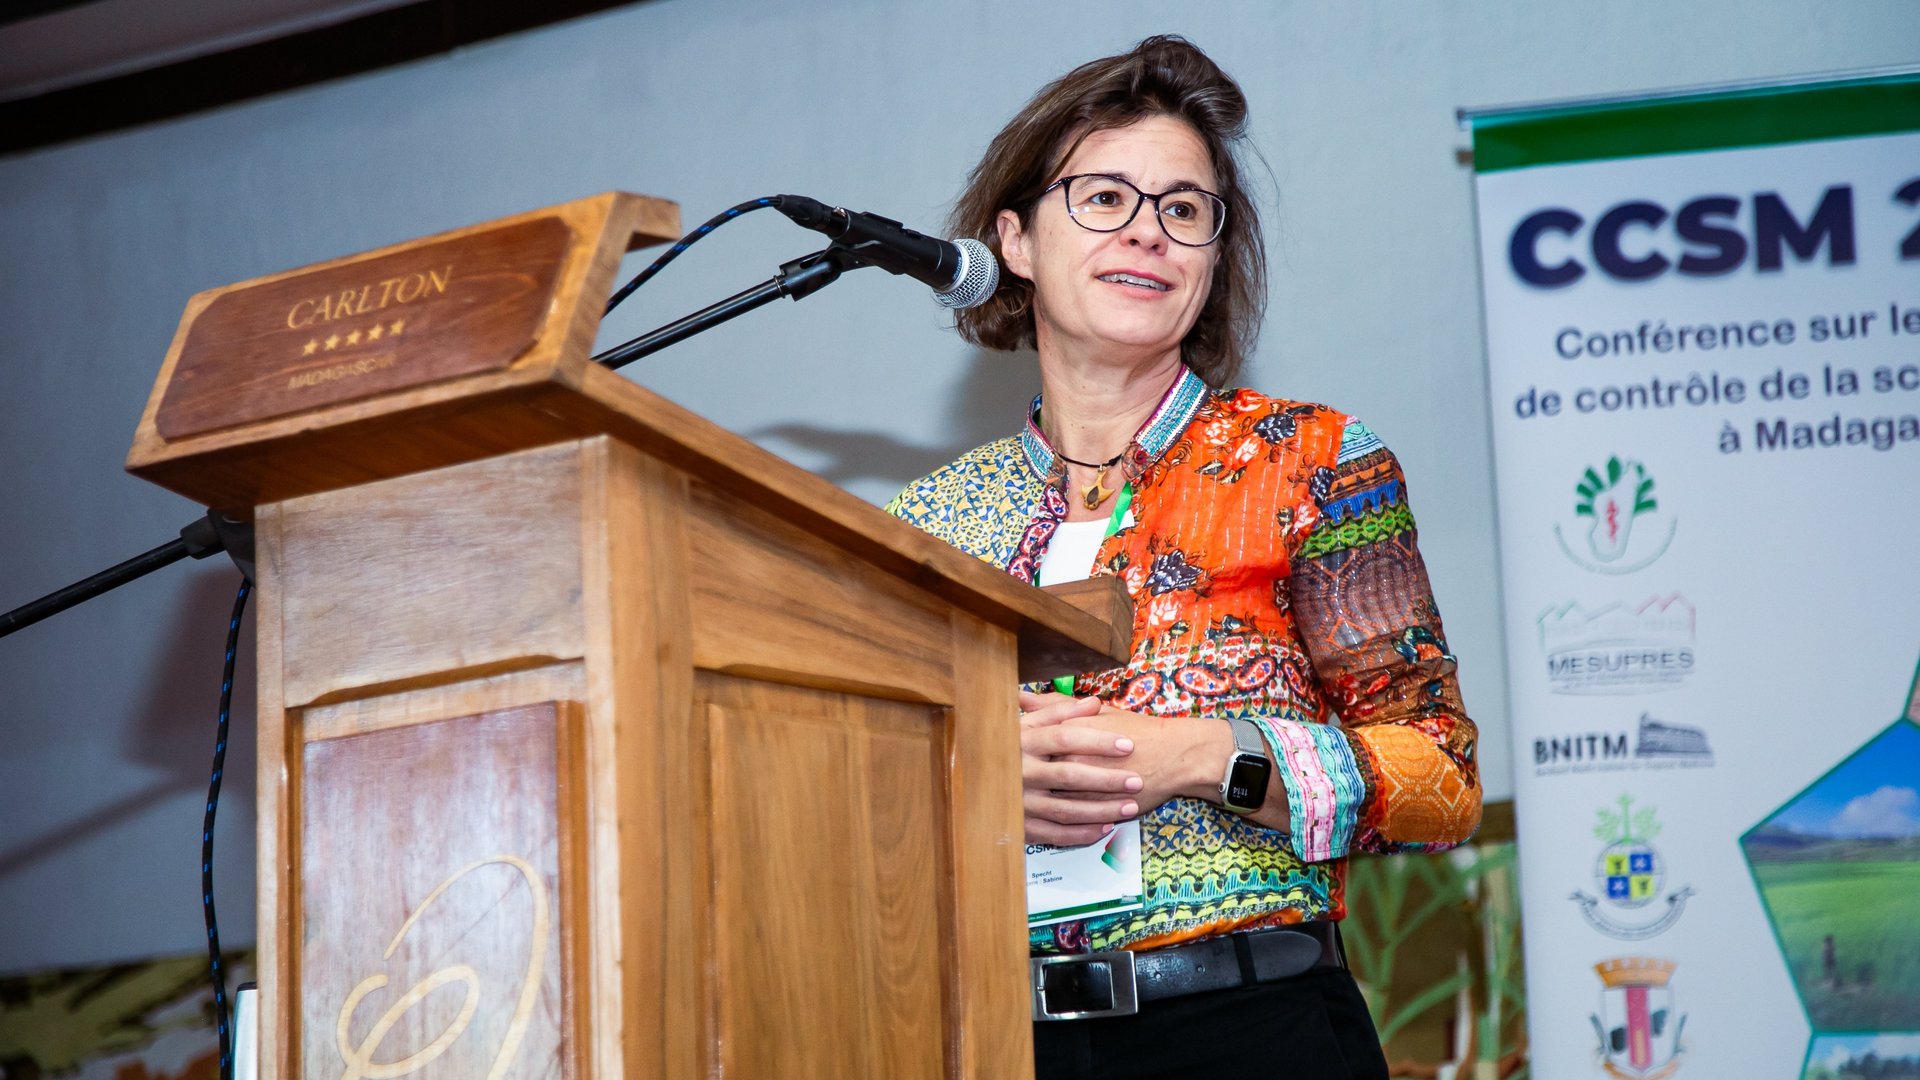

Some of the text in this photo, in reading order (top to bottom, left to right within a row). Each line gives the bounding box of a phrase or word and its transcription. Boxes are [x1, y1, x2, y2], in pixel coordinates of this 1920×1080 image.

[1508, 183, 1857, 289] CCSM
[287, 264, 453, 329] CARLTON
[1556, 319, 1796, 359] Conférence
[1809, 311, 1878, 341] sur
[1515, 363, 1920, 419] de contrôle de la sc
[1719, 412, 1920, 454] à Madaga
[1549, 649, 1695, 676] MESUPRES
[1533, 734, 1628, 765] BNITM
[1031, 870, 1052, 879] Specht
[1042, 875, 1063, 884] Sabine
